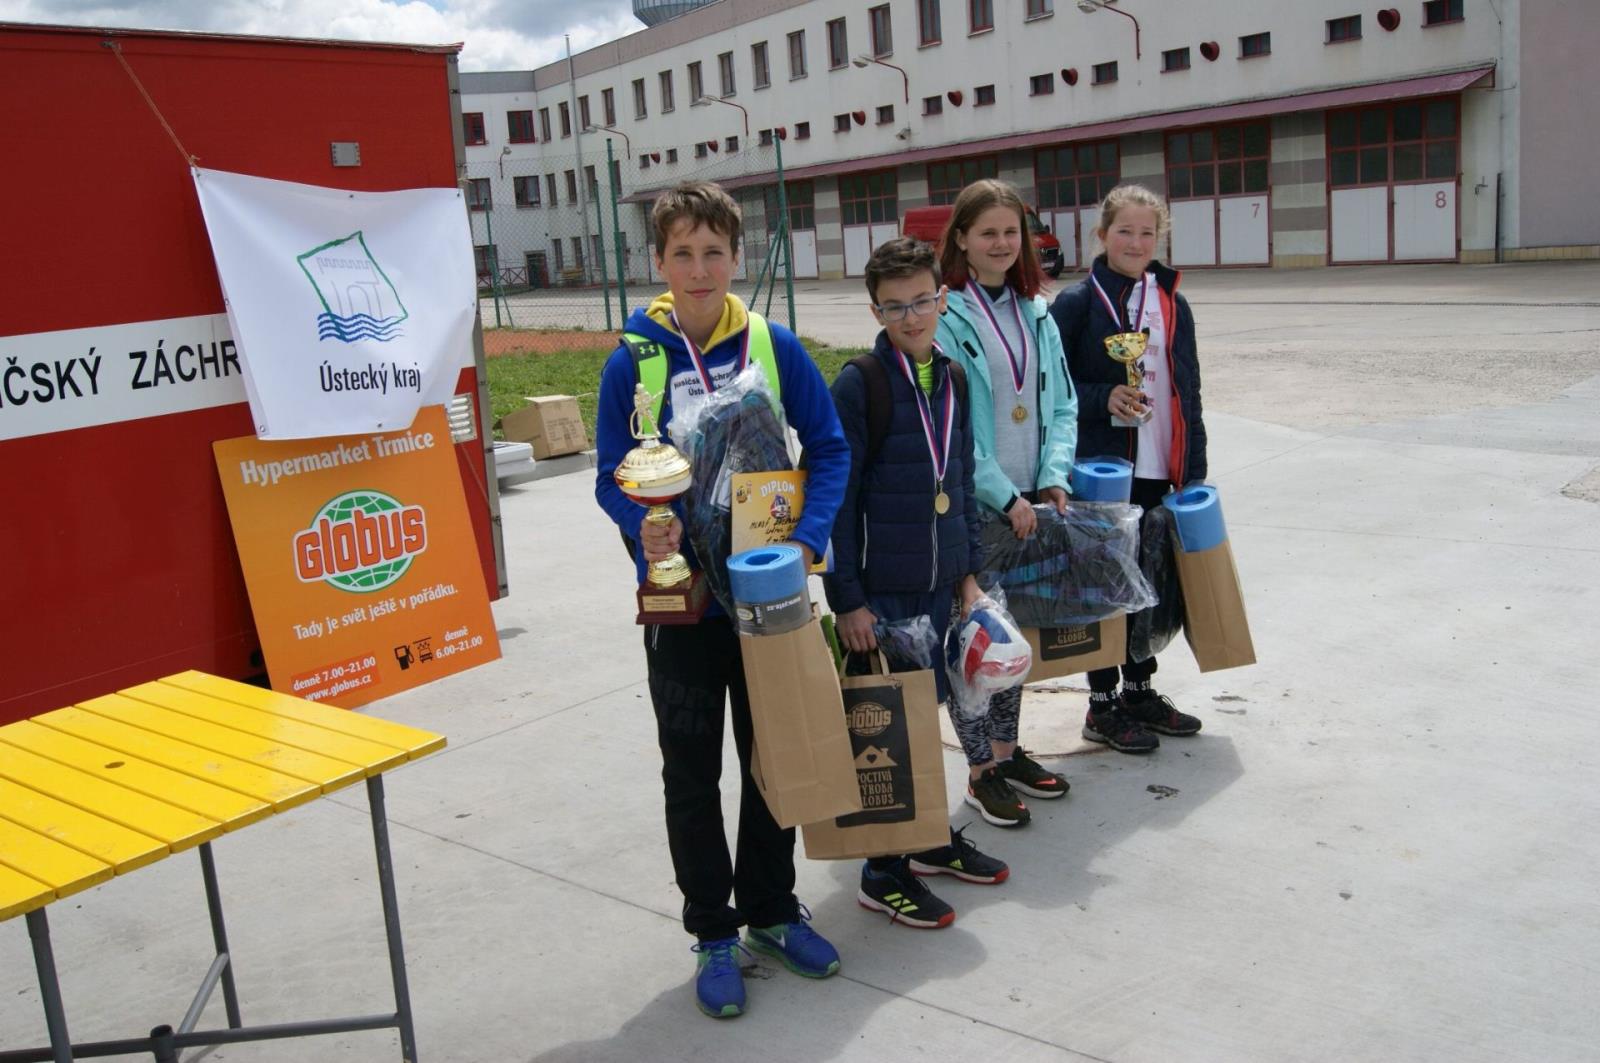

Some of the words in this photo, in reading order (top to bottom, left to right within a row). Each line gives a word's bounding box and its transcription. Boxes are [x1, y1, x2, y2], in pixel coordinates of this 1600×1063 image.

[1435, 190, 1447, 208] 8
[1252, 203, 1260, 218] 7
[0, 347, 101, 408] ČSKÝ
[319, 360, 388, 395] Ústecký
[392, 362, 421, 393] kraj
[239, 441, 372, 487] Hypermarket
[372, 432, 435, 458] Trmice
[760, 480, 796, 497] DIPLOM
[293, 621, 324, 640] Tady
[326, 615, 339, 634] je
[342, 608, 367, 627] svět
[368, 598, 397, 621] ještě
[399, 598, 407, 609] v
[409, 583, 458, 609] pořádku.
[444, 626, 469, 642] denně
[293, 674, 320, 691] denně
[305, 675, 372, 702] www.globus.cz
